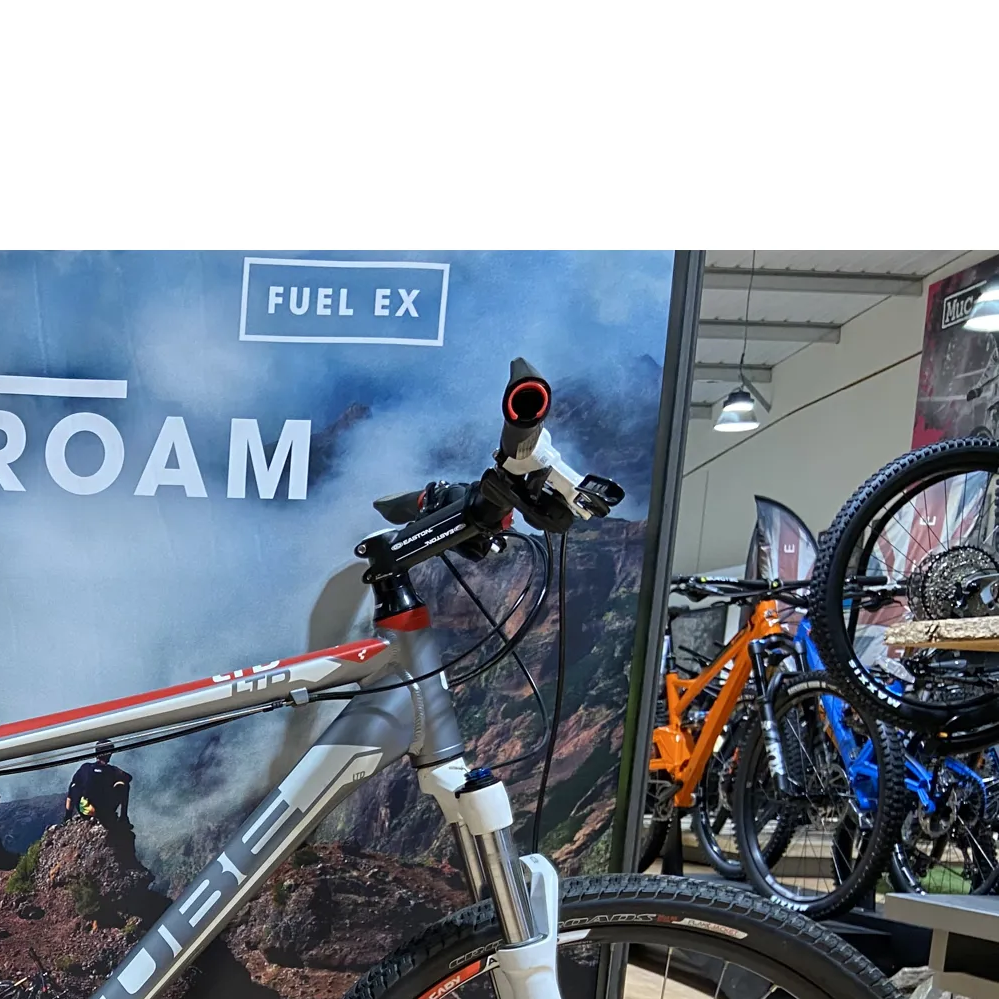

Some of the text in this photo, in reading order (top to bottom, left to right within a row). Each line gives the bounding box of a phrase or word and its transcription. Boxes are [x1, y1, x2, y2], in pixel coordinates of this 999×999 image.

[268, 286, 421, 318] FUEL EX
[402, 527, 434, 546] EASTON
[424, 527, 457, 547] EASTON
